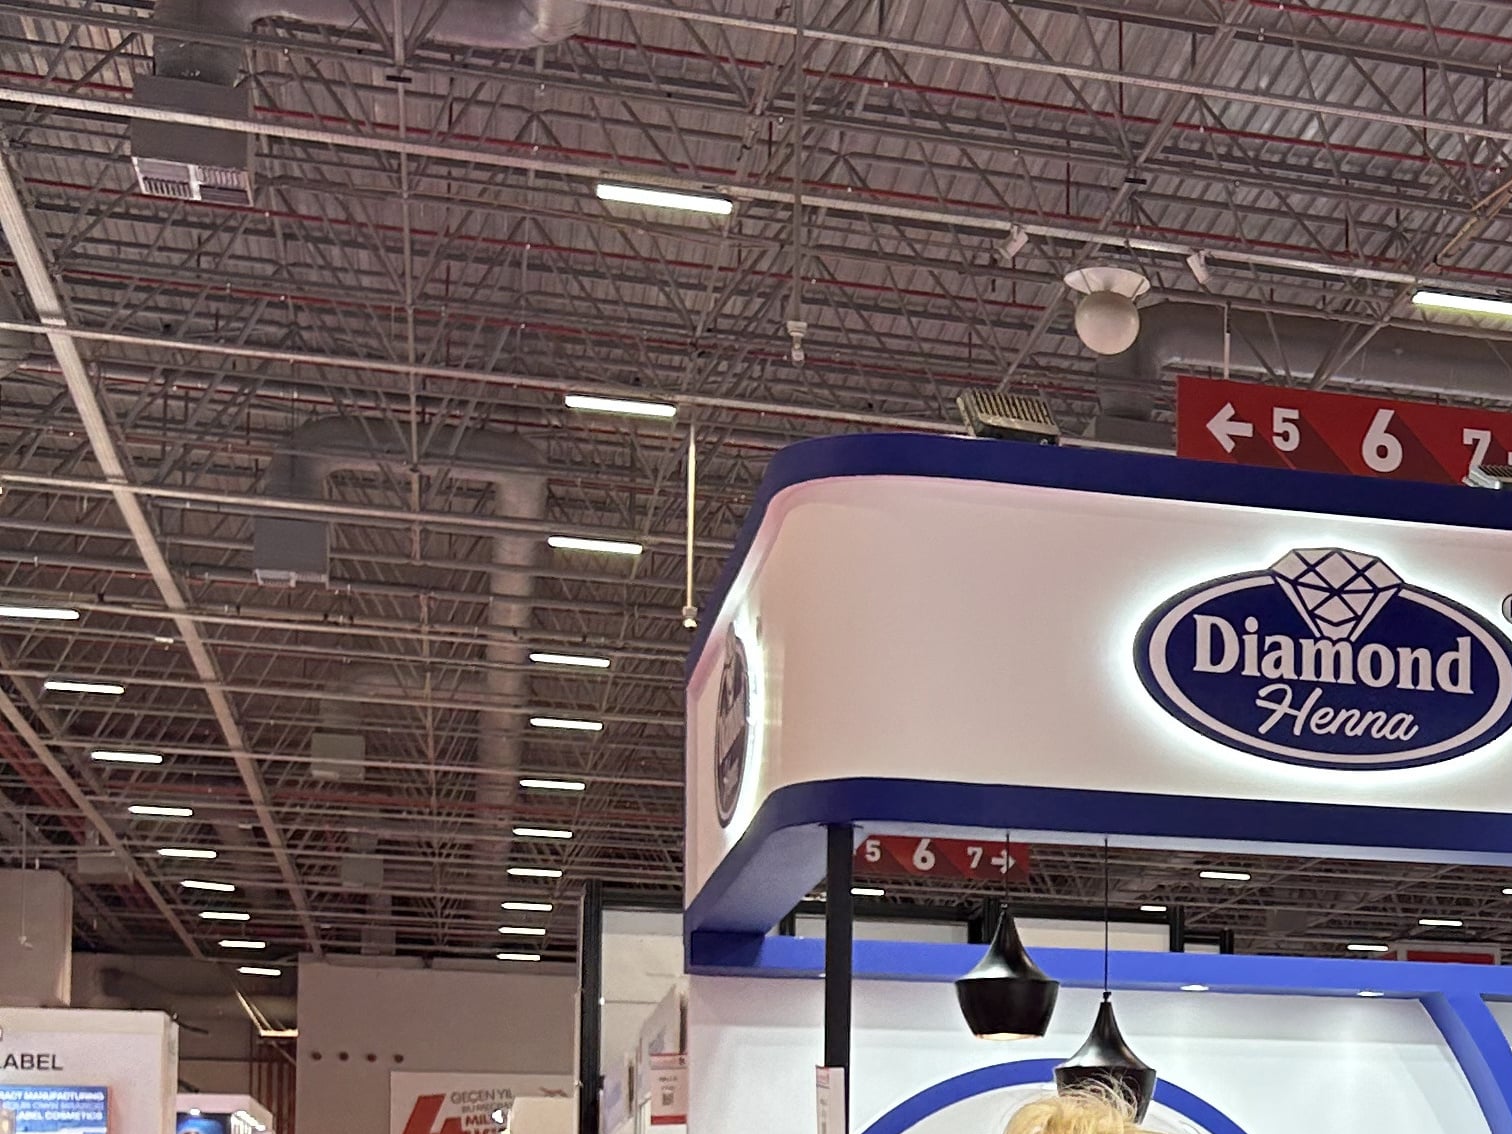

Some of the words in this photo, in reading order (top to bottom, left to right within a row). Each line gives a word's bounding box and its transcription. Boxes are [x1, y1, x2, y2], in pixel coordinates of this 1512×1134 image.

[1272, 408, 1300, 452] 5
[1362, 409, 1402, 473] 6
[1463, 428, 1492, 473] 7
[1193, 614, 1474, 694] Diamond
[1256, 683, 1418, 741] Henna
[865, 841, 881, 863] 5
[912, 838, 936, 871] 6
[967, 847, 983, 869] 7
[0, 1054, 63, 1070] ABEL
